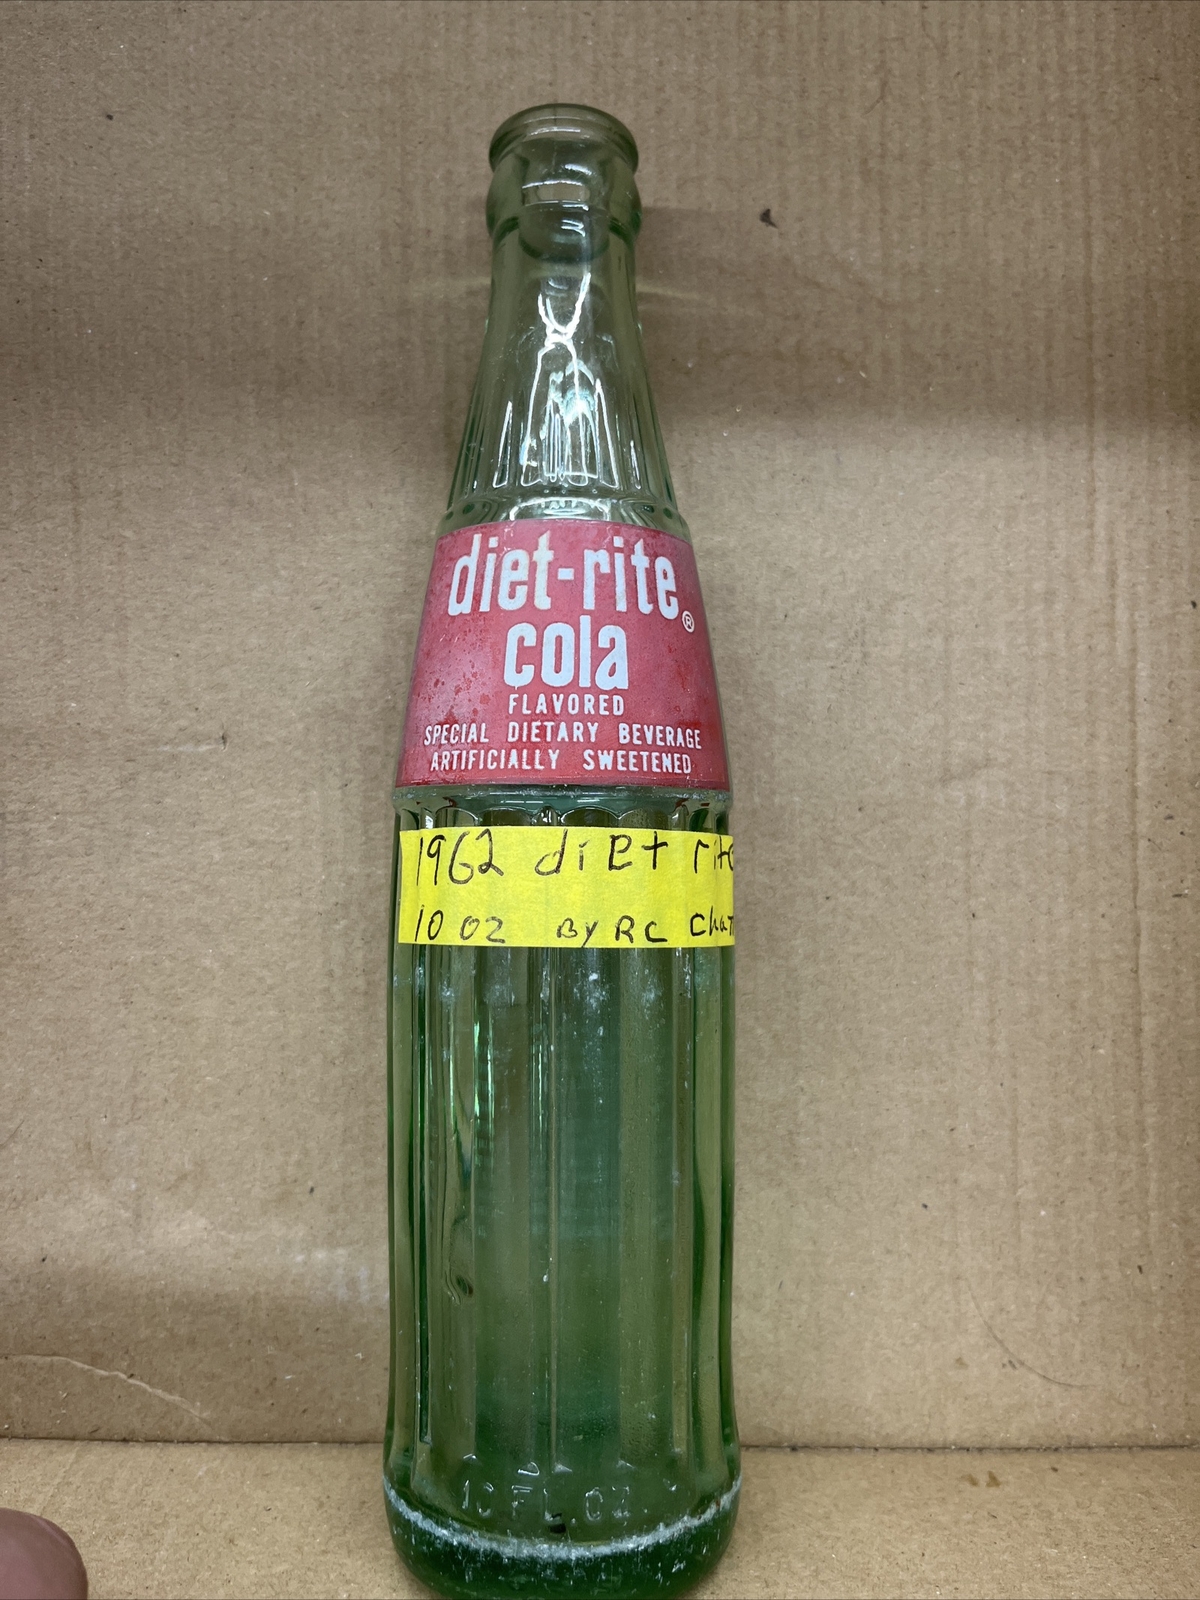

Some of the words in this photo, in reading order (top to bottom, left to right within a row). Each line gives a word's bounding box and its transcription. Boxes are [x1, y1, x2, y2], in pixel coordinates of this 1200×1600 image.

[447, 530, 679, 620] diet-rite
[503, 615, 629, 690] cola
[508, 694, 625, 715] FLAVORED
[423, 722, 490, 746] SPECIAL
[507, 721, 599, 743] DIETARY
[618, 723, 702, 749] BEVERAGE
[430, 749, 560, 772] ARTIFICIALLY
[582, 749, 692, 774] SWEETENED
[416, 828, 504, 886] 1962
[414, 904, 444, 942] 10
[614, 914, 669, 943] RC
